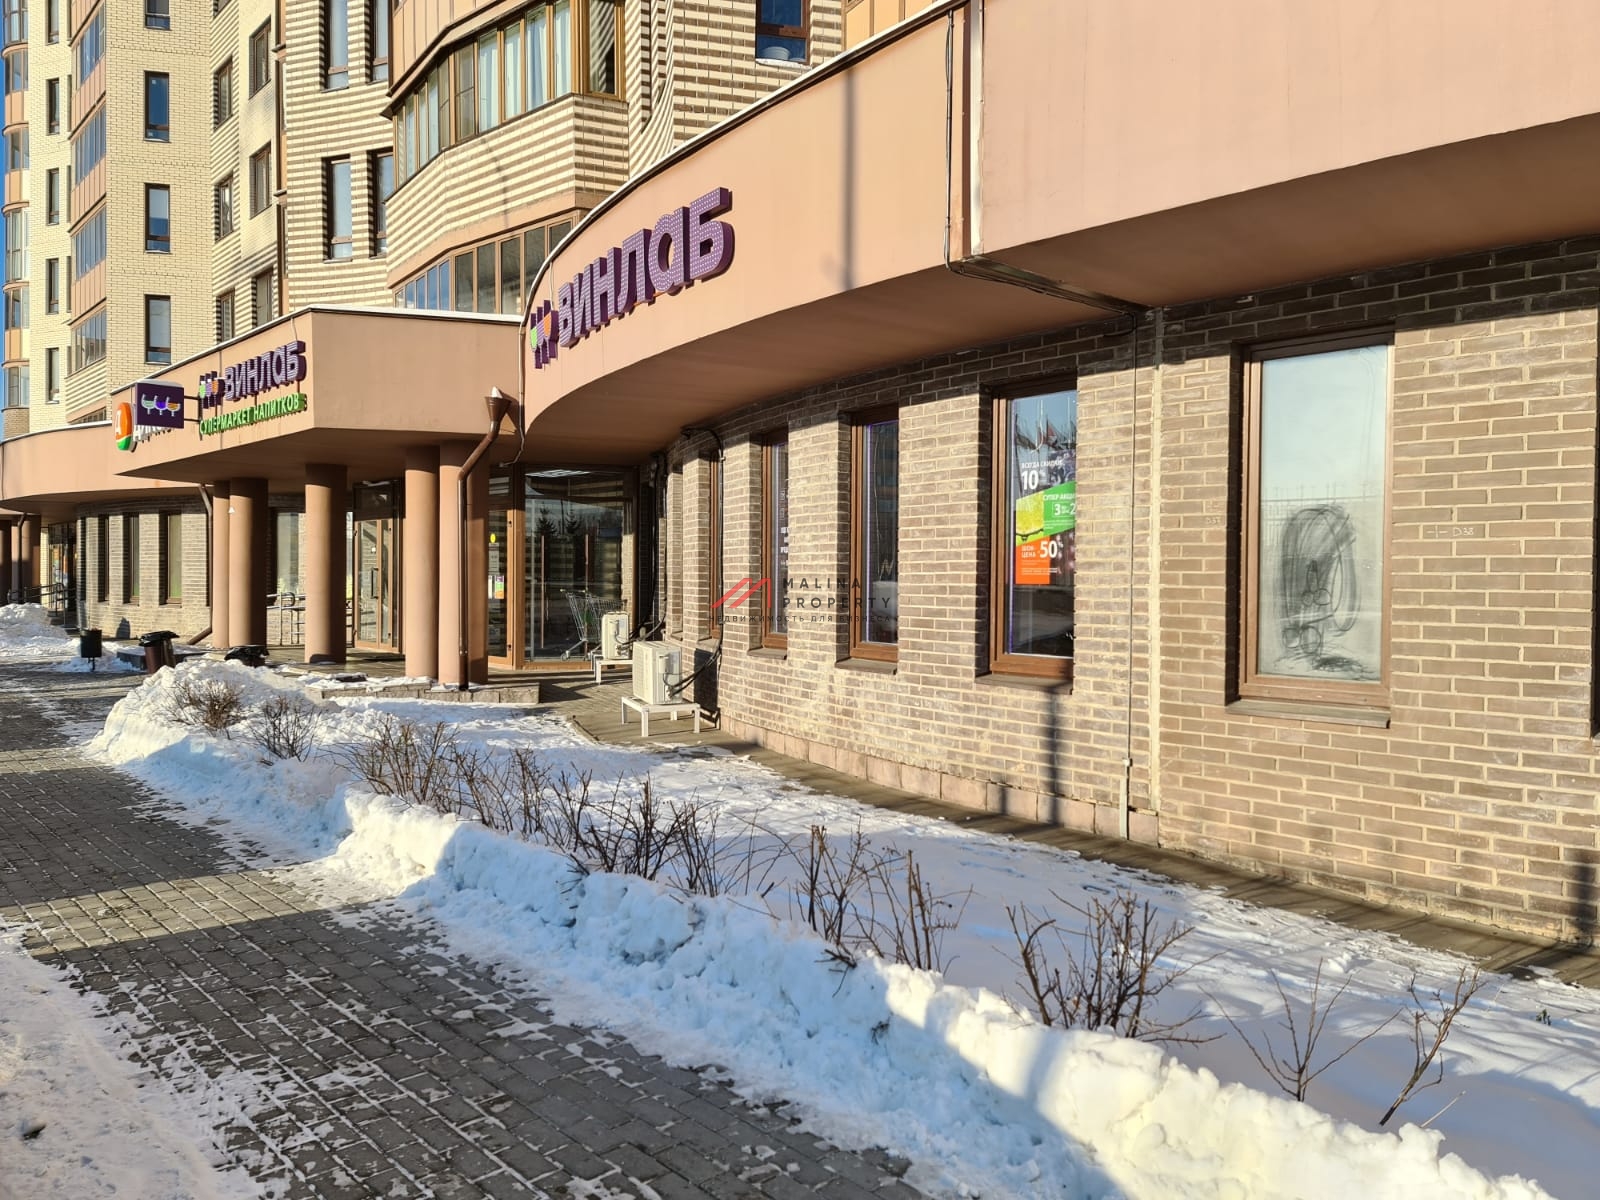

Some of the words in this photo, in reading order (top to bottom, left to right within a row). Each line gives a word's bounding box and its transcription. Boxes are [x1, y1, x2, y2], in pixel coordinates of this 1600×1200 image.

[200, 407, 253, 435] СУПЕРМАРКЕТ
[254, 393, 303, 422] НАПИТКОВ
[1054, 503, 1061, 516] 3
